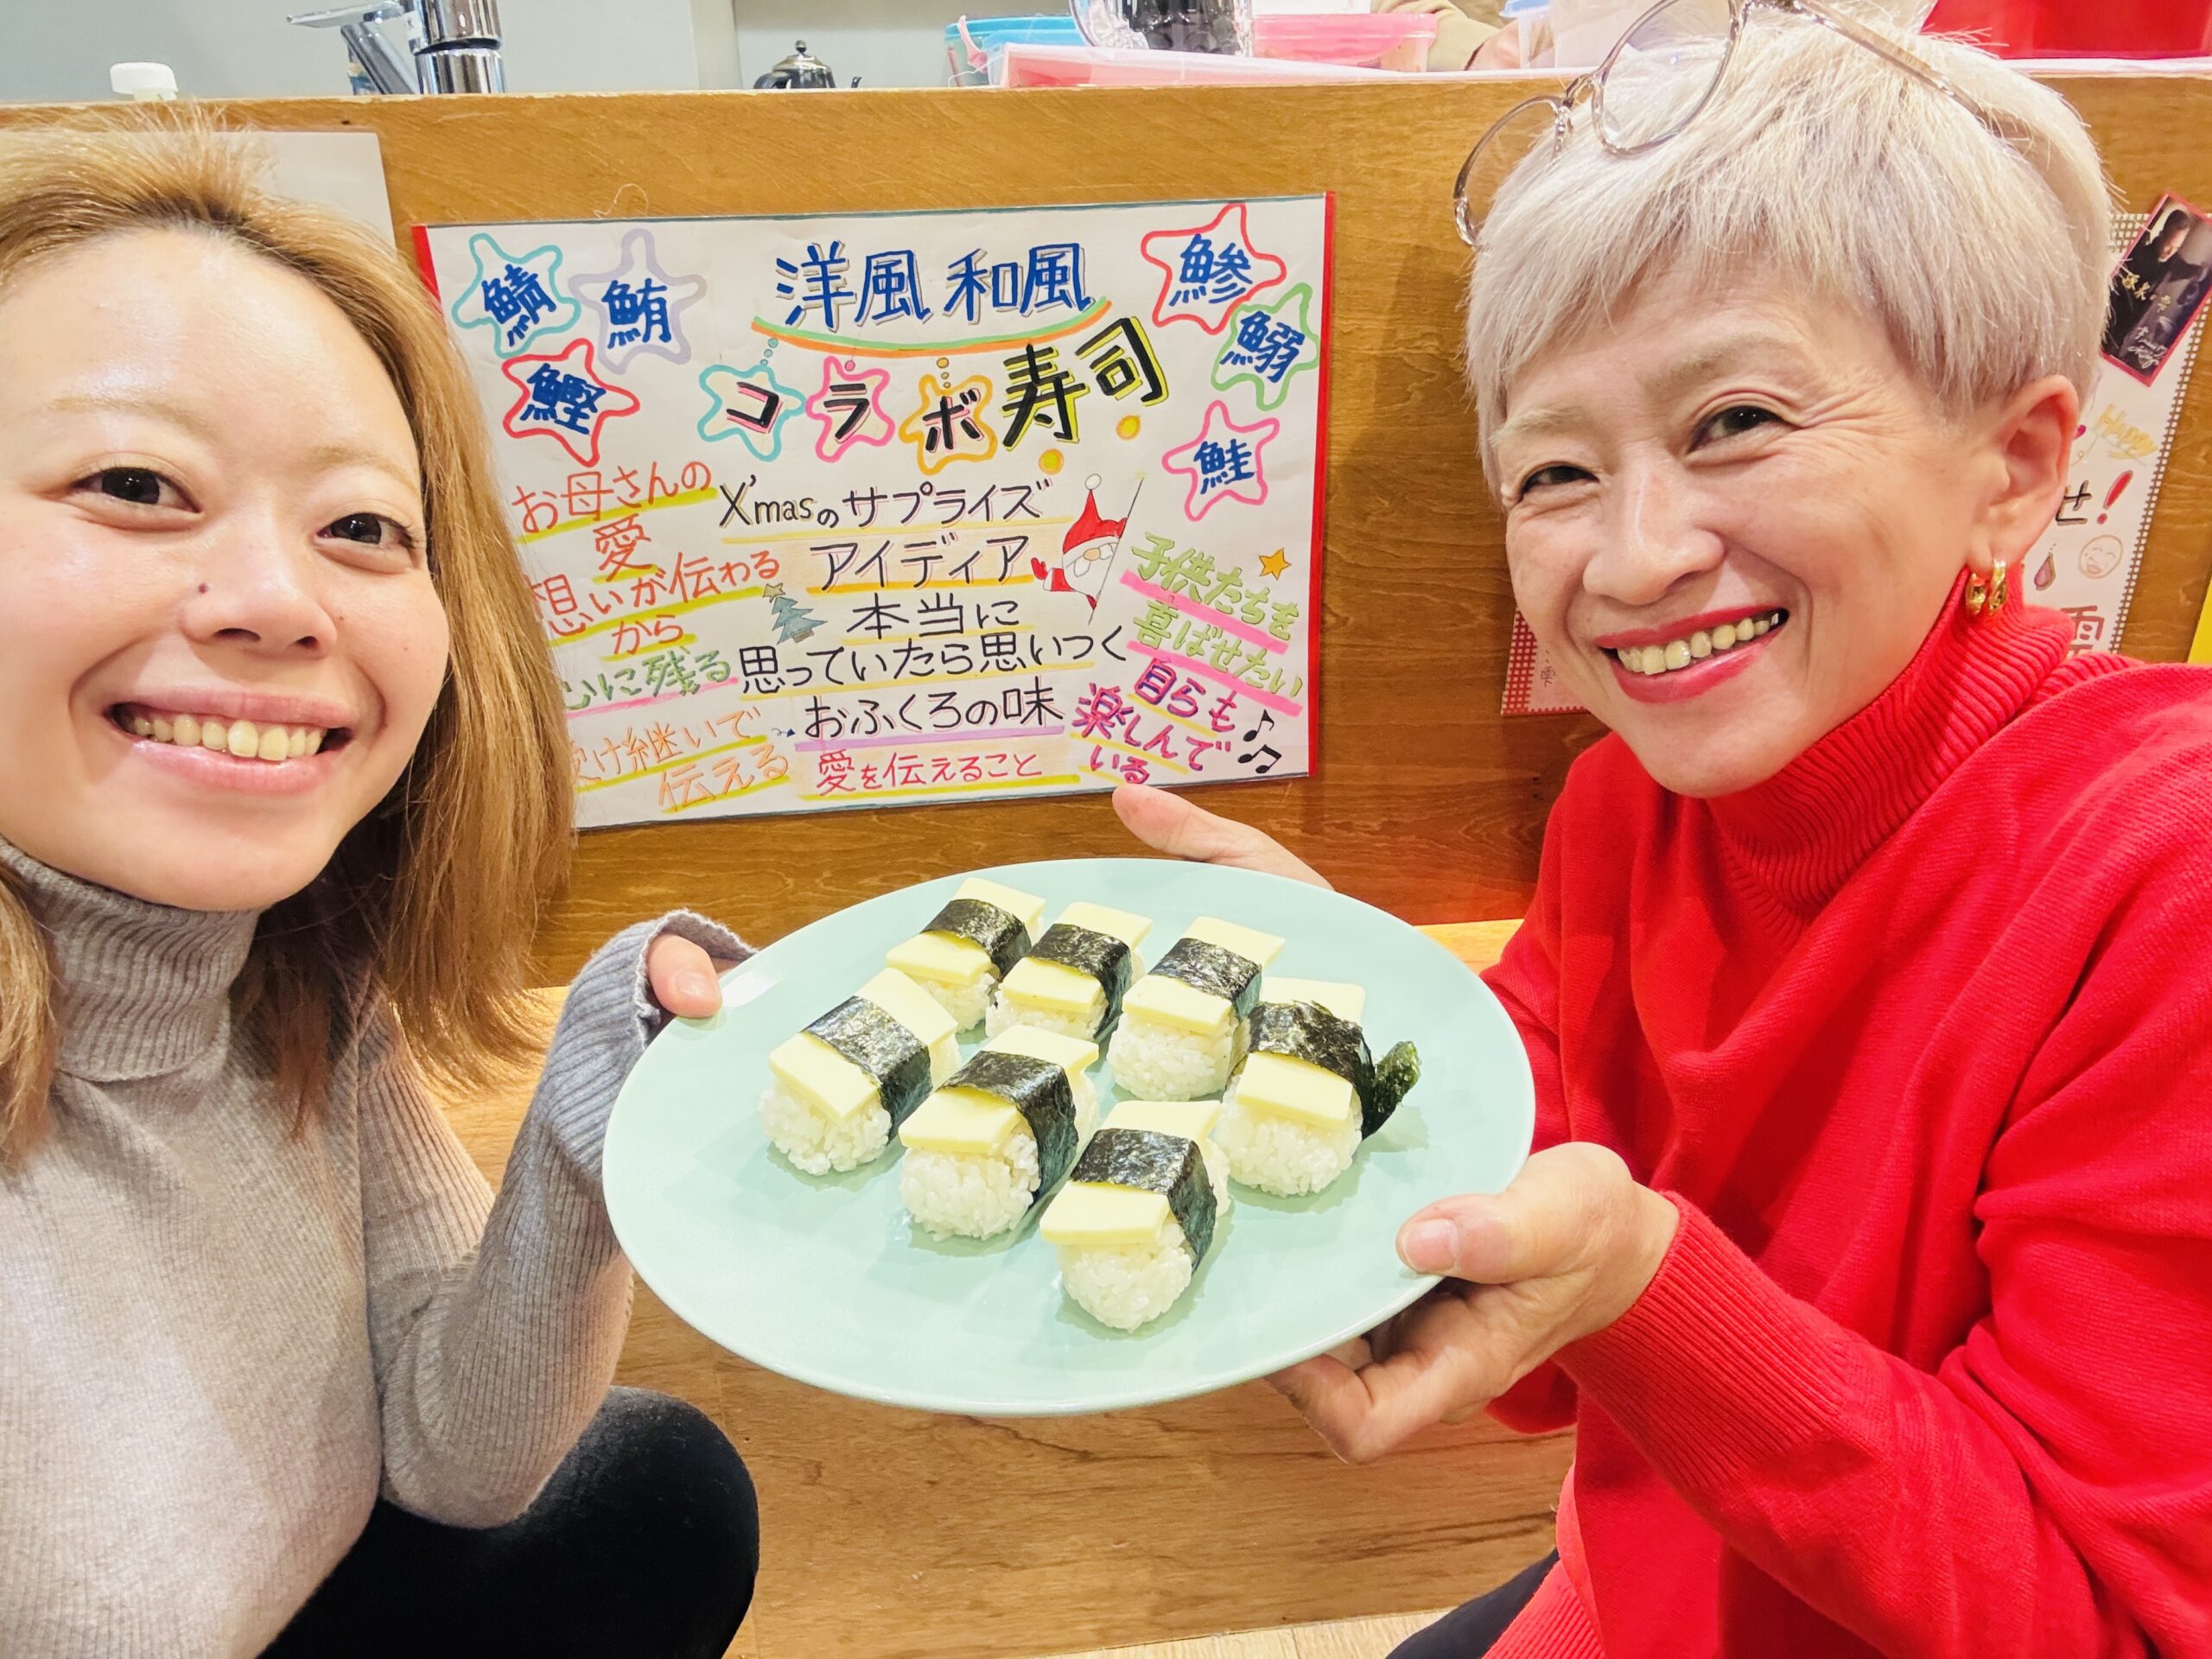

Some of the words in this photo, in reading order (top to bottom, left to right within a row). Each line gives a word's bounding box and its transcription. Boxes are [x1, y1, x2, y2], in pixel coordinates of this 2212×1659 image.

[481, 264, 556, 346] 鯖
[601, 277, 671, 349] 鮪
[1220, 310, 1305, 383] 鰯
[520, 363, 607, 435] 鰹
[512, 461, 711, 533] お母さんの
[1193, 439, 1255, 494] 鮭
[594, 513, 652, 582] 愛
[810, 532, 1029, 592] アイディア
[529, 550, 779, 637] 想いが伝わる
[847, 593, 1020, 639] 本当に
[1131, 531, 1300, 641] 子供たちを
[611, 613, 683, 655] から
[741, 625, 1127, 695] 思っていたら思いつく
[1133, 595, 1303, 699] 喜ばせたい
[804, 676, 1065, 740] おふくろの味
[1071, 683, 1231, 771] 楽しんで
[1135, 658, 1237, 732] 自らも
[658, 743, 789, 811] 伝える
[817, 749, 1042, 797] 愛を伝えること
[1090, 745, 1150, 785] いる
